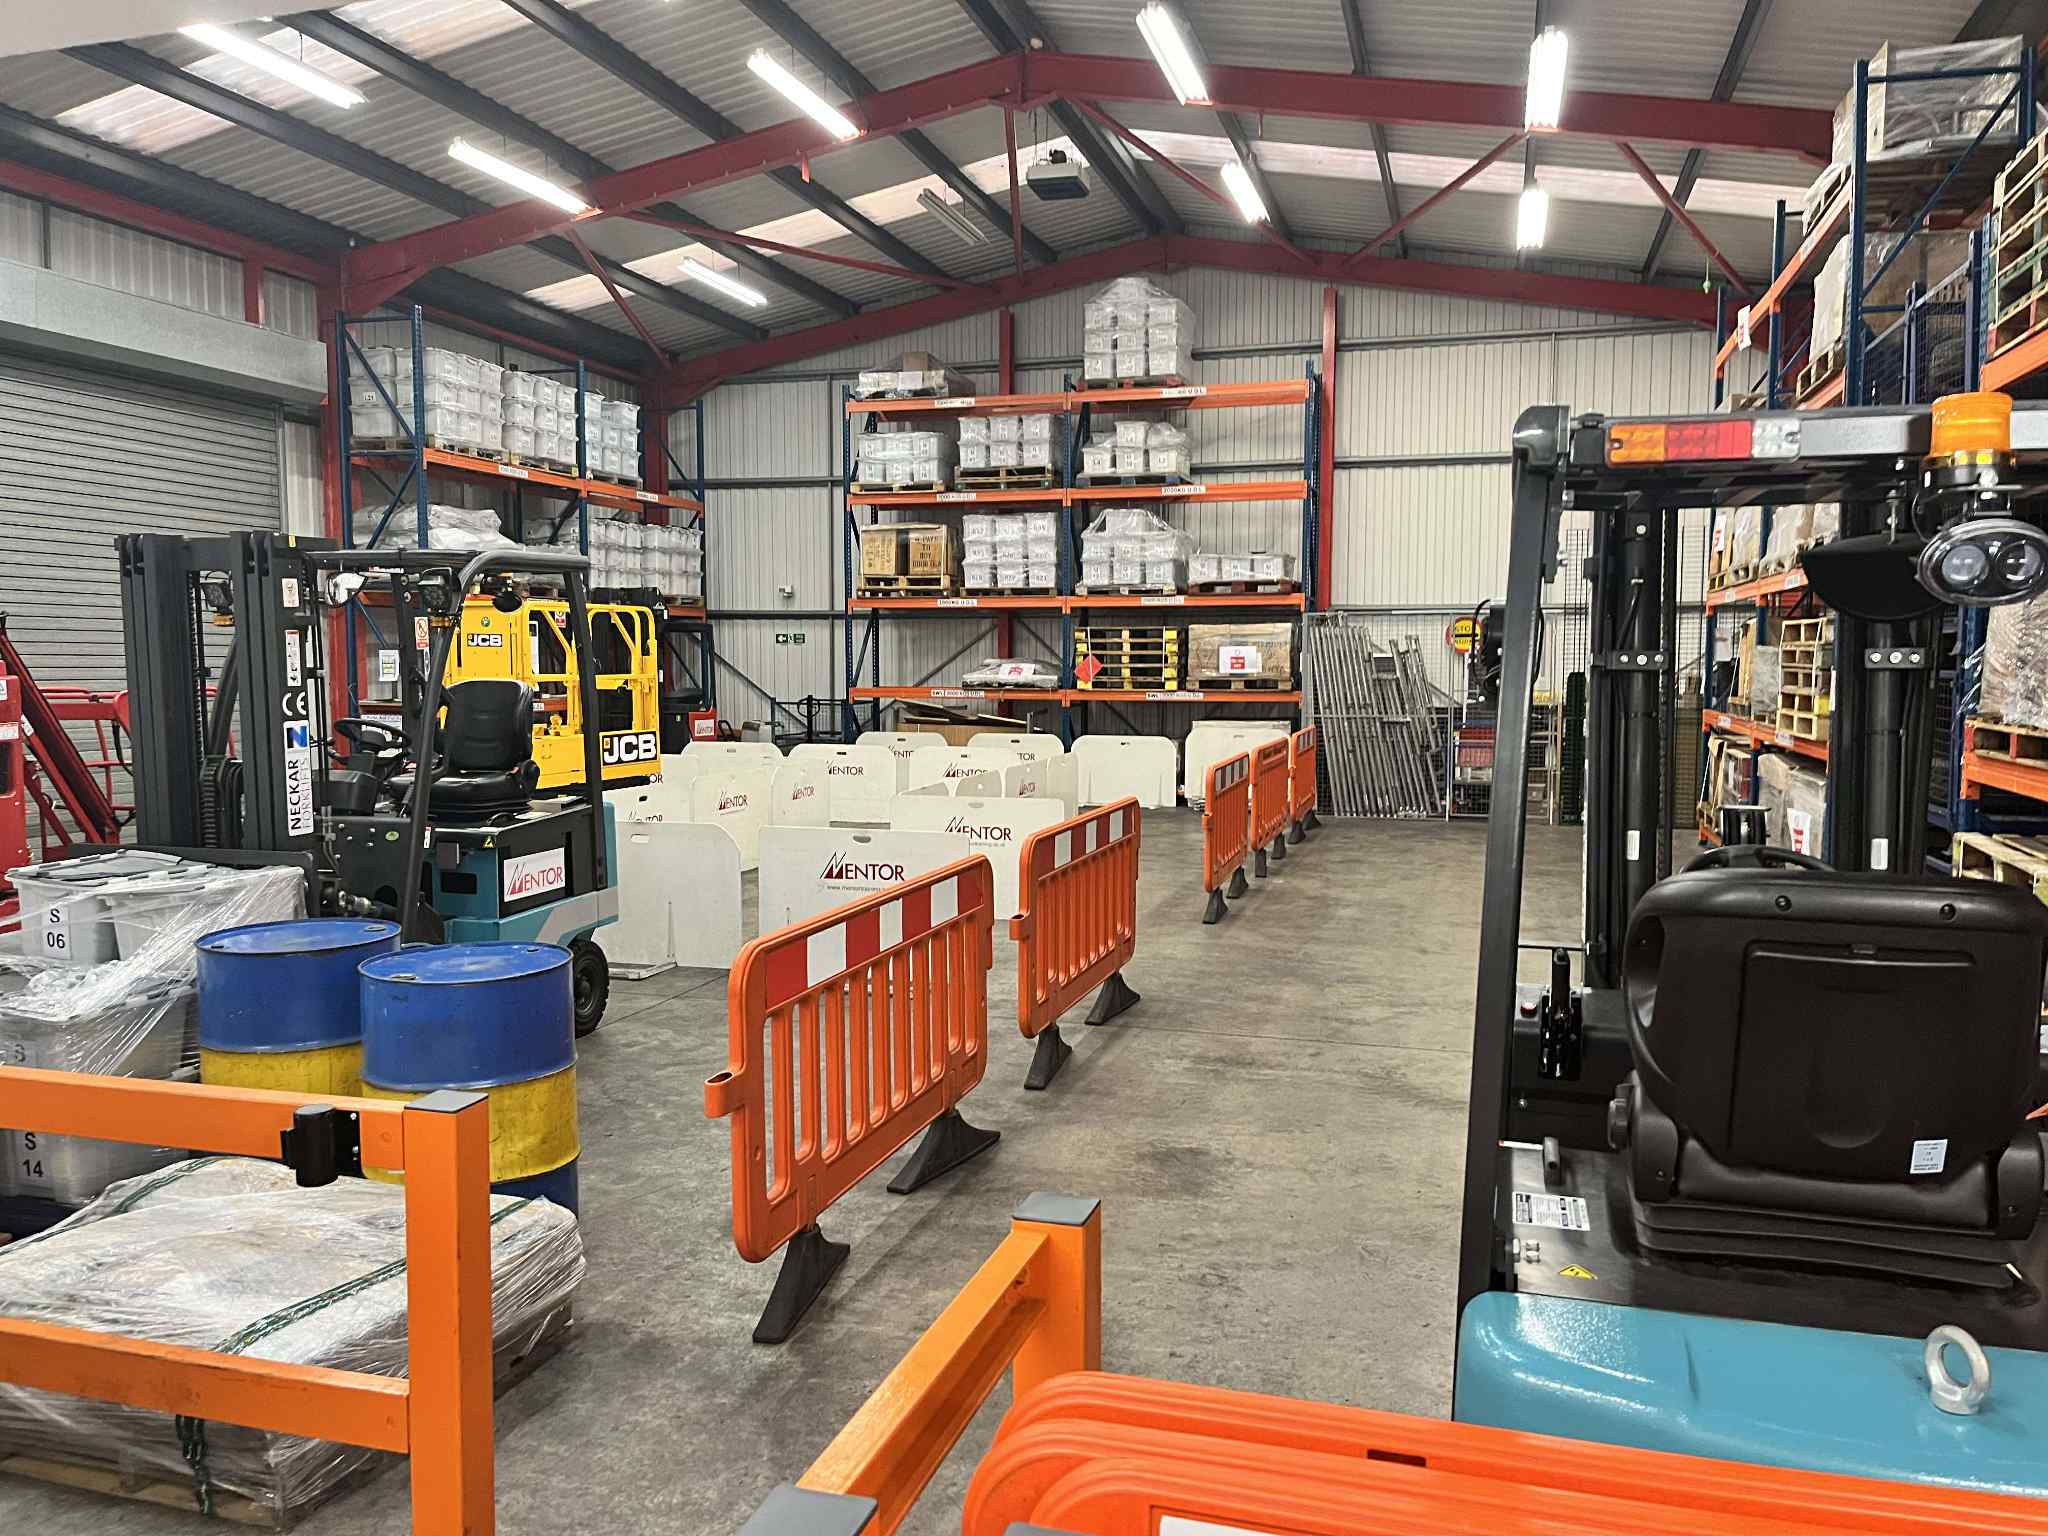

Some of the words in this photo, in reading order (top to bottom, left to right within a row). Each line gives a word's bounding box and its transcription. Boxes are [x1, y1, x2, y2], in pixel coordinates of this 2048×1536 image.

[468, 634, 502, 646] JCB
[603, 733, 656, 764] JCB
[288, 759, 301, 830] NECKAR
[718, 789, 749, 810] MENTOR
[792, 783, 815, 800] MENTOR
[820, 851, 905, 881] MENTOR
[507, 861, 564, 895] MENTOR
[50, 908, 60, 923] S
[47, 932, 66, 949] 06
[24, 1132, 37, 1150] S
[22, 1159, 44, 1178] 14
